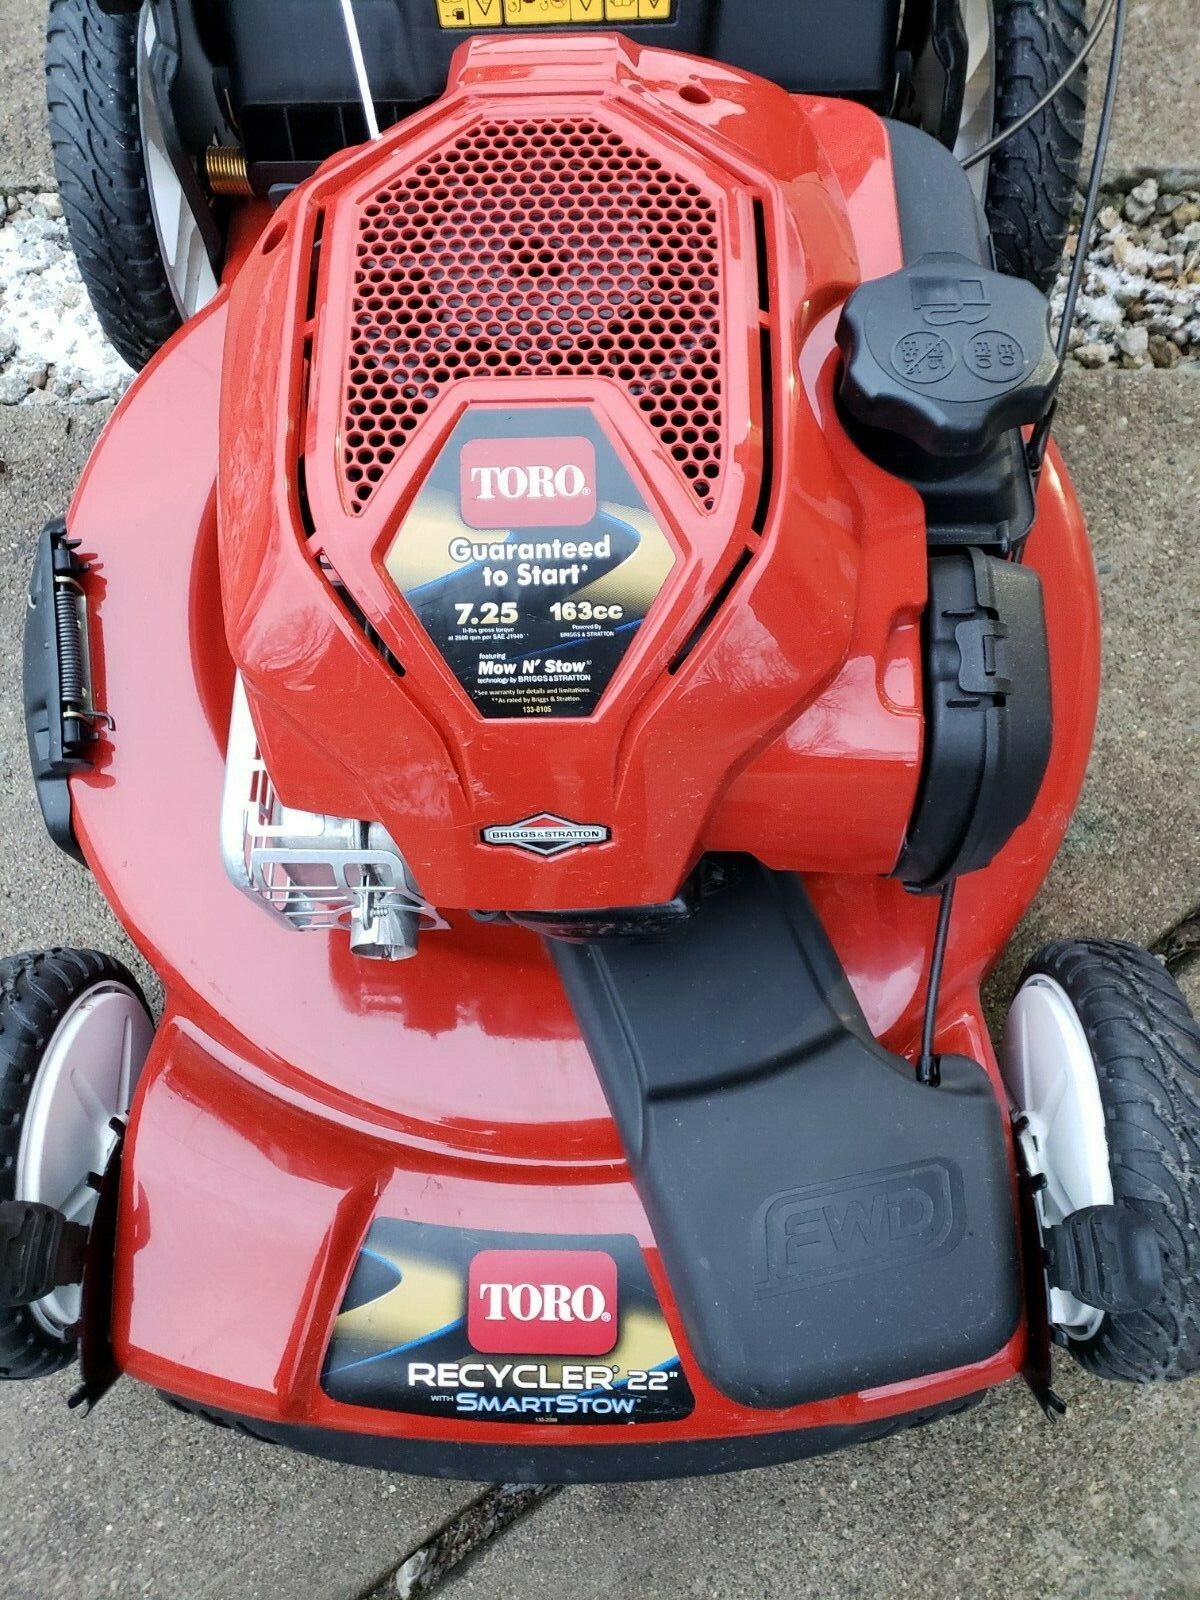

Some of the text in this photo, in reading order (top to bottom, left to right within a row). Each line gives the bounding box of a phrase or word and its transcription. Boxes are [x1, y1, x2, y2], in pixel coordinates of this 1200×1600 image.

[471, 464, 585, 500] TORO
[449, 534, 611, 561] Guaranteed
[483, 565, 508, 587] to
[454, 601, 519, 625] 7.25
[549, 601, 624, 621] 163cc
[478, 661, 517, 675] Mow
[544, 659, 586, 673] Stow
[785, 1188, 934, 1265] FWD
[480, 1283, 605, 1322] TORO
[408, 1363, 678, 1391] RECYCLER 22"
